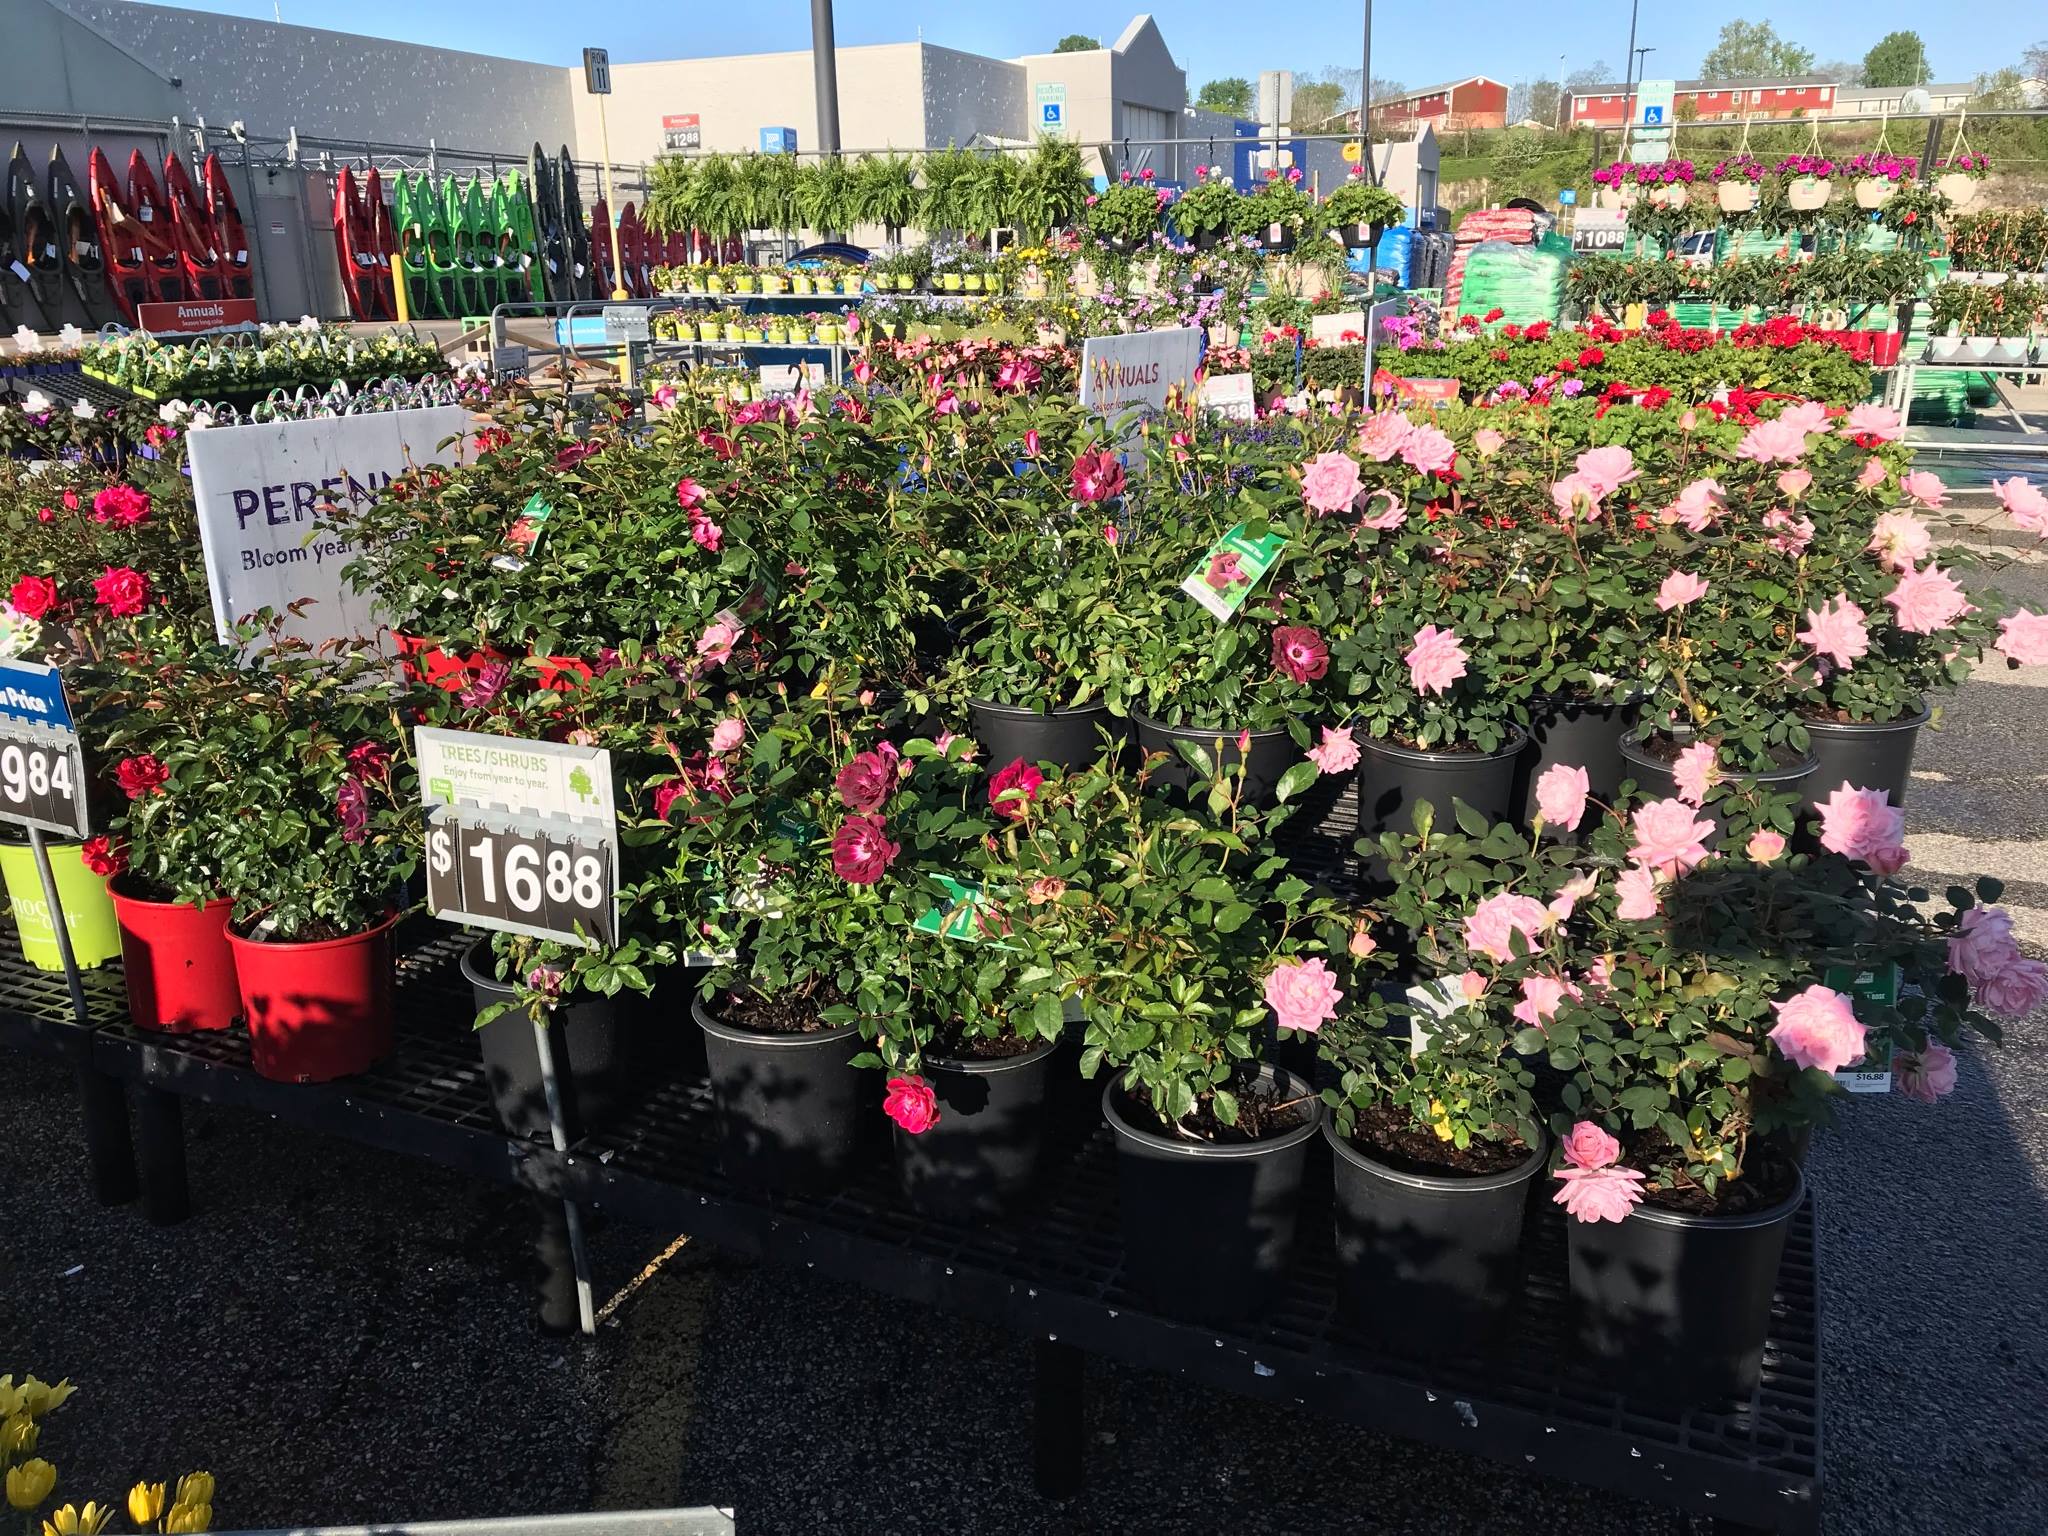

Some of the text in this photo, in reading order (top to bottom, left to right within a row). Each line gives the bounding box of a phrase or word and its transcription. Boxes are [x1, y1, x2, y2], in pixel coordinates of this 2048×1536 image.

[591, 51, 606, 65] ROW
[596, 67, 607, 89] 11
[1585, 230, 1625, 248] 1088
[178, 304, 224, 318] Annuals
[1093, 363, 1160, 392] ANNUALS
[231, 460, 462, 530] PEREN
[241, 544, 307, 571] Bloom
[312, 540, 353, 565] year
[7, 687, 48, 714] Price
[444, 765, 549, 790] Enjoy from year to year.
[1856, 1073, 1884, 1081] $16.88
